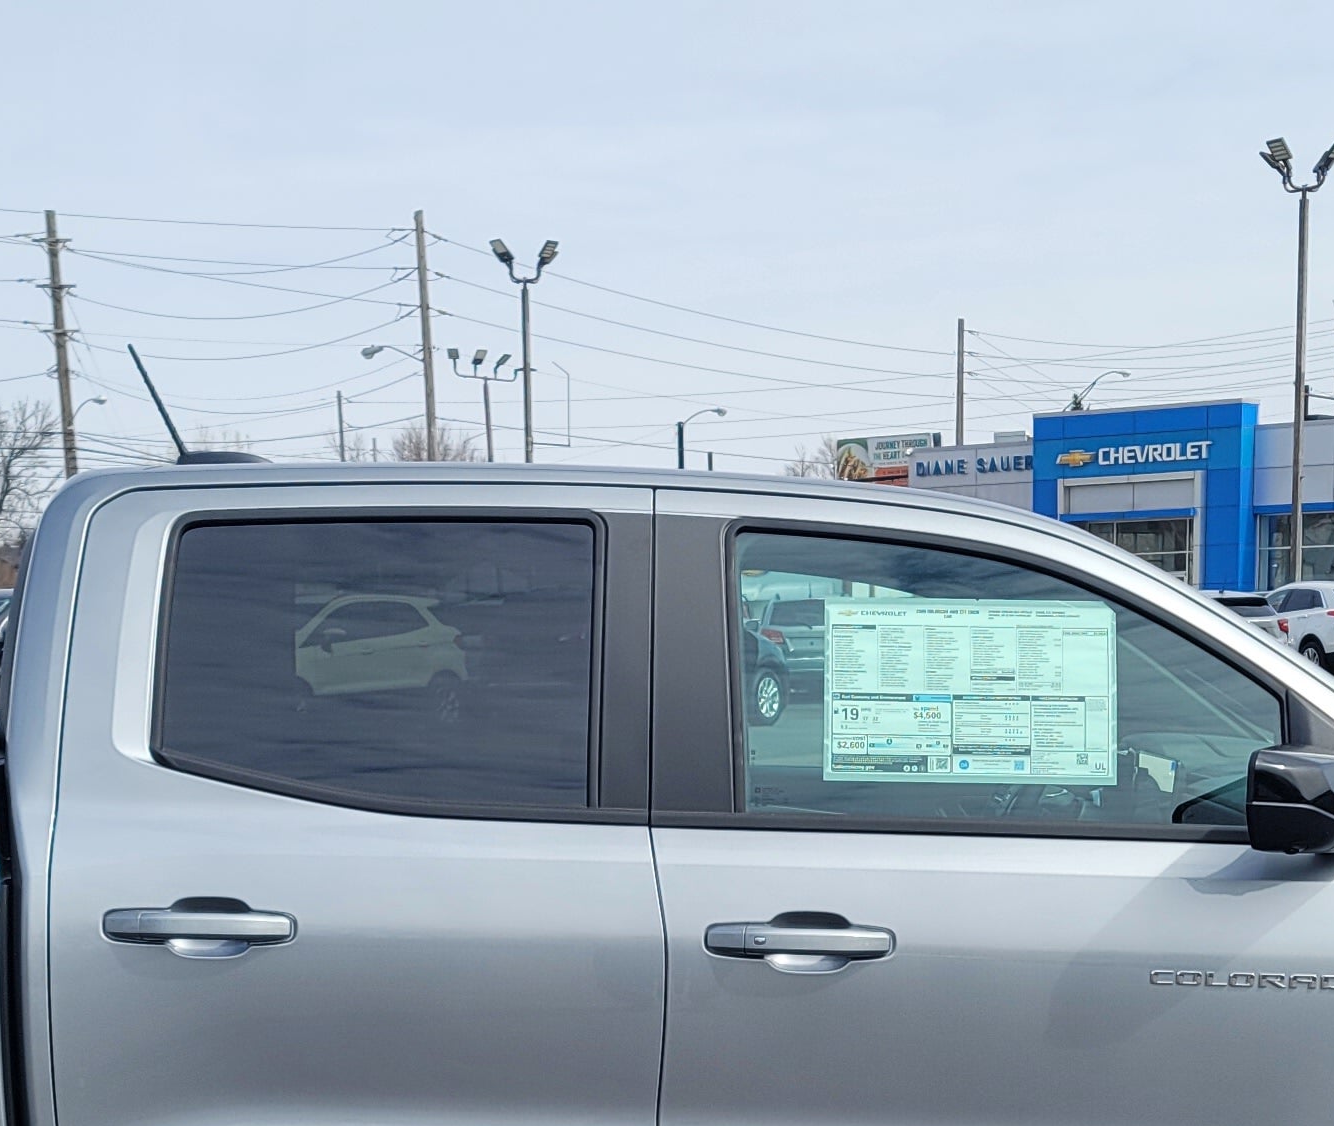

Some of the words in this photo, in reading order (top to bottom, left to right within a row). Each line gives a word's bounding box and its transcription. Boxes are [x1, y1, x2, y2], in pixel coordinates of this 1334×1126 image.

[1098, 441, 1212, 465] CHEVROLET
[916, 459, 967, 477] DIANE
[976, 455, 1034, 473] SAUER
[841, 707, 860, 721] 19
